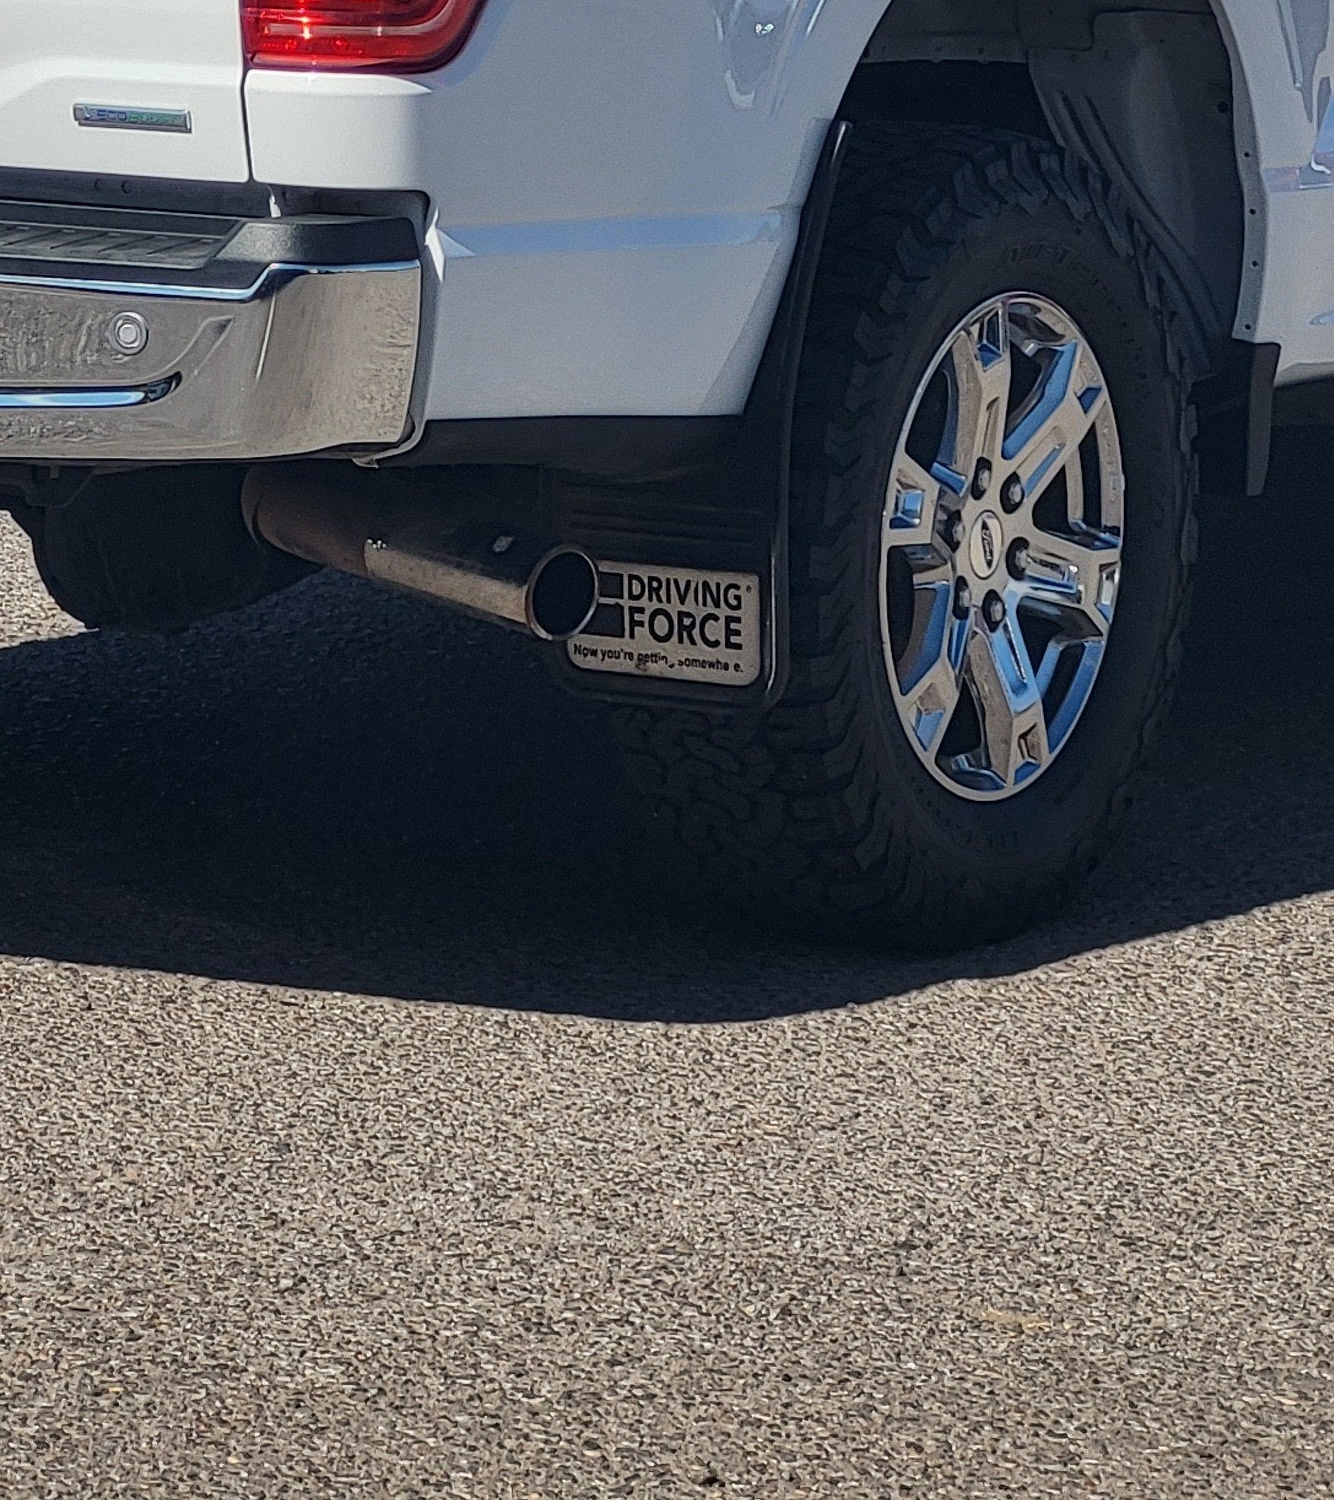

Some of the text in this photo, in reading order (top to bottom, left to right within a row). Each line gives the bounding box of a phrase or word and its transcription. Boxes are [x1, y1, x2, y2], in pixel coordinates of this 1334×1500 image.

[627, 574, 742, 611] DRIVING
[628, 606, 743, 650] FORCE
[573, 643, 598, 657] Now
[601, 648, 634, 661] you're
[637, 652, 675, 669] gettin
